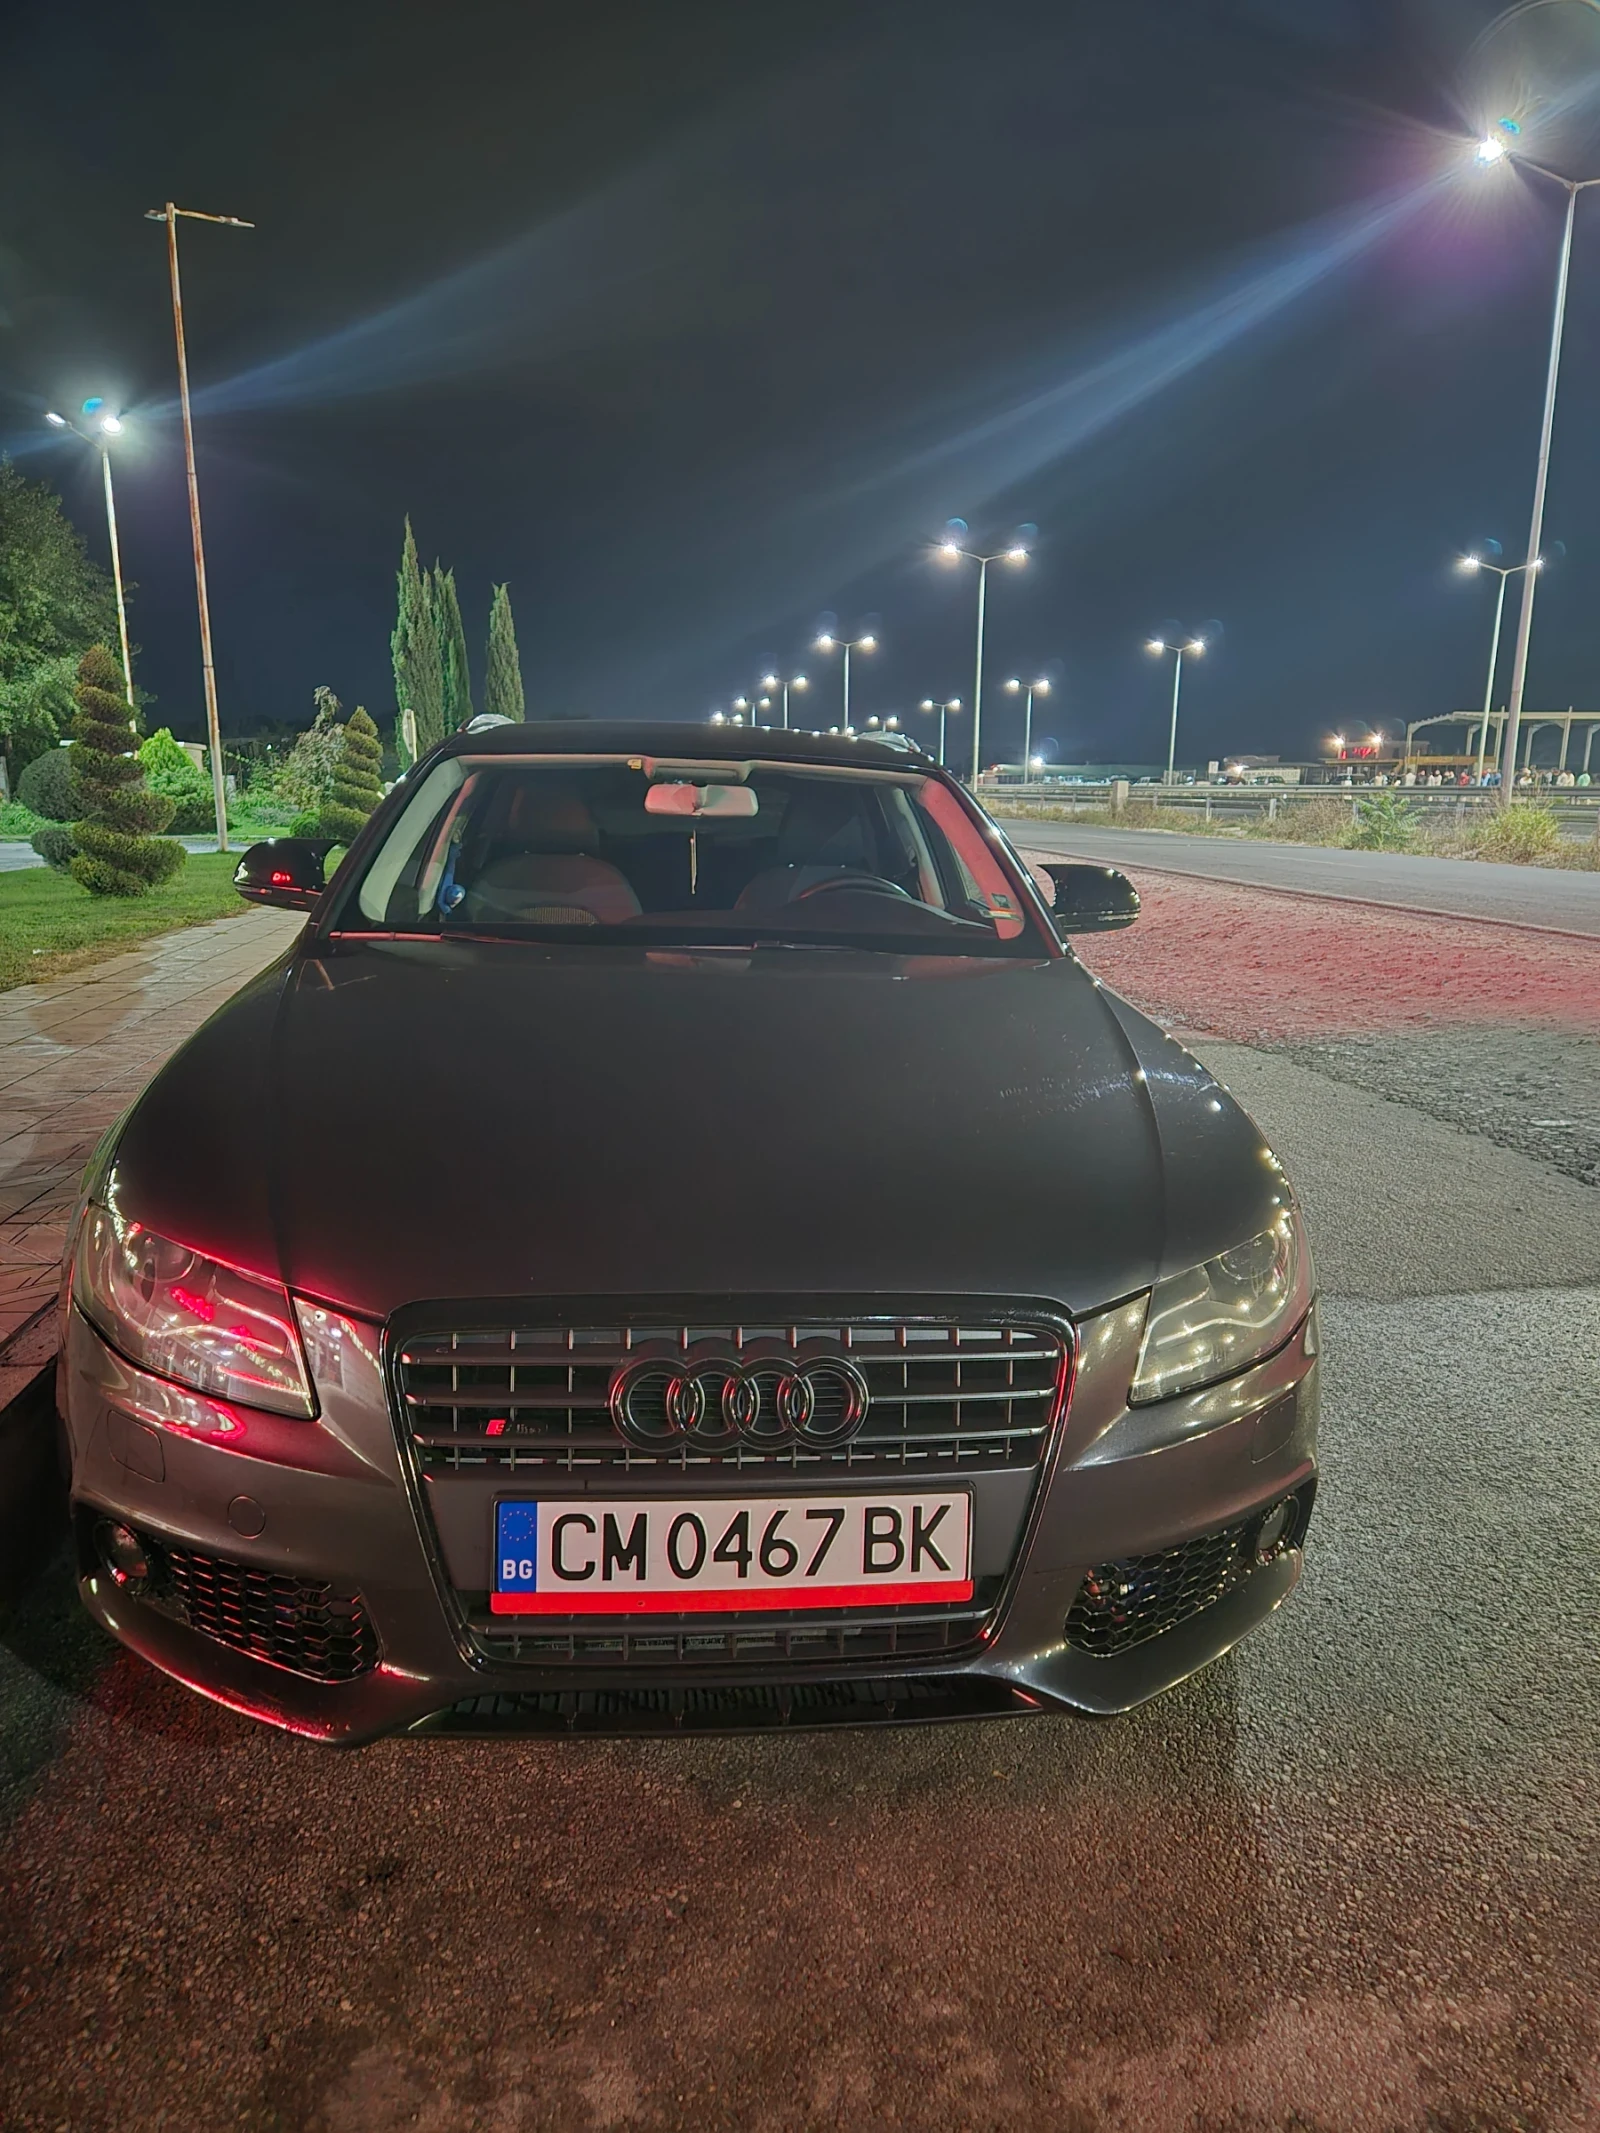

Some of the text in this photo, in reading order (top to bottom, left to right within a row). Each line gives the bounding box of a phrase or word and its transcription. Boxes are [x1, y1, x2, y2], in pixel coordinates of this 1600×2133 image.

[550, 1504, 953, 1581] CM 0467 BK
[502, 1559, 534, 1580] BG
